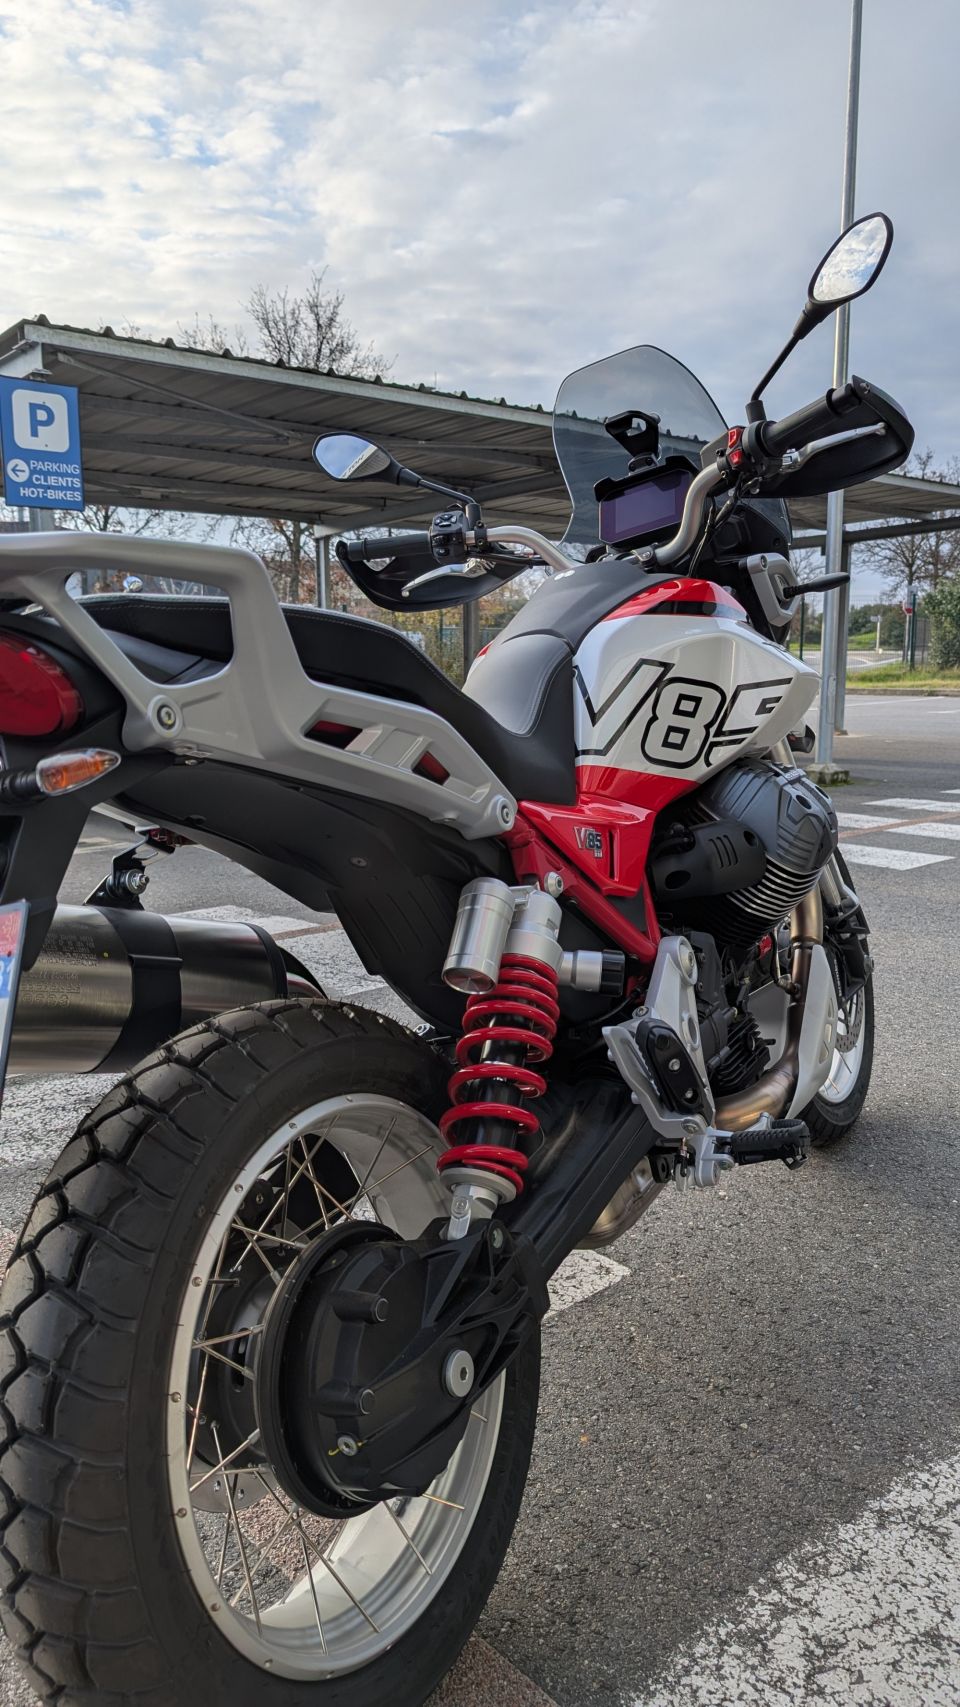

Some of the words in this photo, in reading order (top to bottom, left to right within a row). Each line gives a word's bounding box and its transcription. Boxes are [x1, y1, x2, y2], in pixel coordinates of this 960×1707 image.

[29, 402, 55, 437] P
[30, 461, 79, 474] PARKING
[32, 475, 80, 488] CLIENTS
[20, 487, 81, 500] HOT-BIKES
[573, 826, 603, 850] V85
